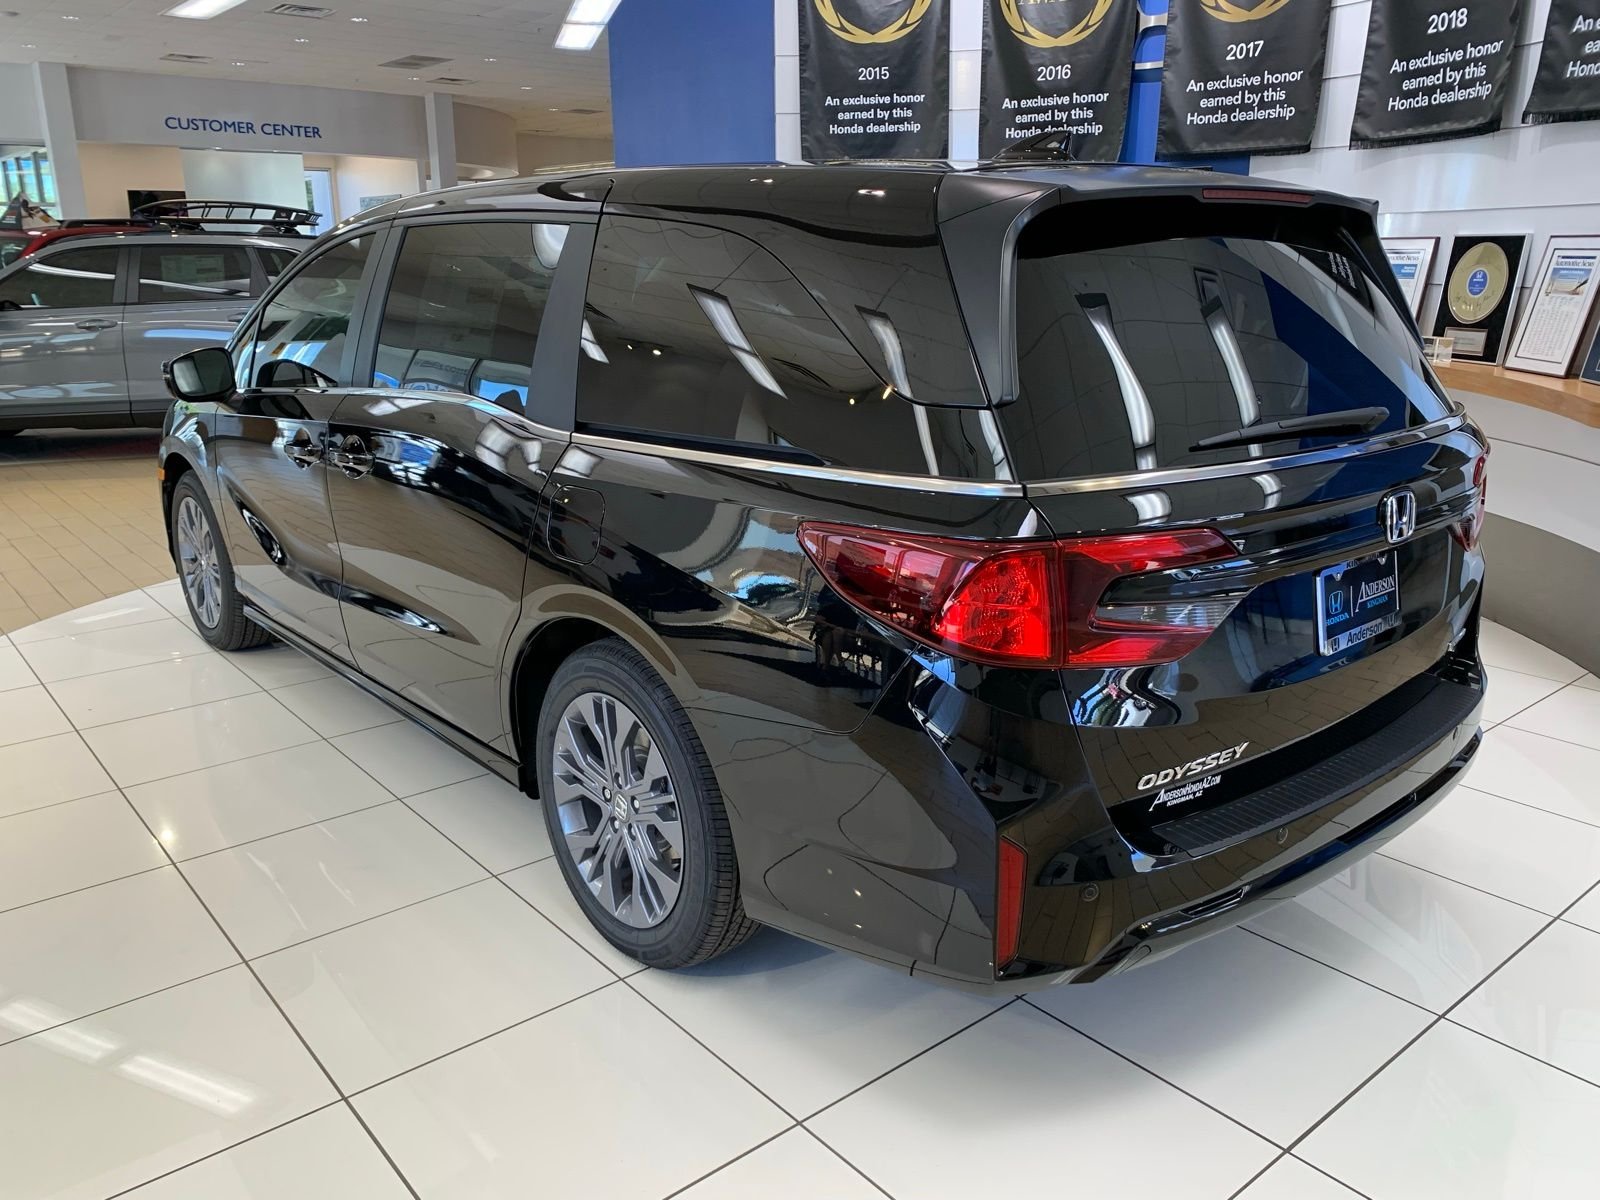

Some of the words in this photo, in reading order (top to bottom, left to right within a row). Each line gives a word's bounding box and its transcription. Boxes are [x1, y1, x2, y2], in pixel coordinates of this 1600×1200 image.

[1427, 8, 1468, 35] 2018
[1572, 15, 1593, 33] An
[1226, 40, 1265, 61] 2017
[1390, 59, 1408, 74] An
[1409, 49, 1463, 70] exclusive
[1466, 38, 1504, 60] honor
[858, 66, 889, 81] 2015
[1037, 64, 1071, 81] 2016
[1186, 78, 1205, 93] An
[1206, 73, 1261, 90] exclusive
[1263, 68, 1304, 85] honor
[1402, 73, 1444, 90] earned
[1446, 67, 1464, 87] by
[1465, 62, 1487, 80] this
[824, 95, 840, 106] An
[842, 94, 891, 105] exclusive
[893, 92, 925, 104] honor
[1002, 98, 1019, 109] An
[1021, 94, 1070, 108] exclusive
[1072, 91, 1109, 105] honor
[1199, 92, 1242, 109] earned
[1243, 90, 1262, 107] by
[1263, 86, 1286, 102] this
[1388, 92, 1429, 112] Honda
[1431, 81, 1492, 107] dealership
[837, 109, 874, 120] earned
[876, 108, 890, 121] by
[892, 107, 912, 118] this
[1015, 111, 1051, 124] earned
[1054, 109, 1069, 124] by
[1070, 107, 1093, 121] this
[1186, 110, 1228, 126] Honda
[1230, 104, 1295, 123] dealership
[164, 116, 257, 135] CUSTOMER
[260, 122, 322, 139] CENTER
[829, 123, 864, 135] Honda
[866, 121, 921, 136] dealership
[1005, 126, 1042, 139] Honda
[1355, 574, 1395, 613] ANDERSON
[1347, 621, 1383, 646] Anderson
[1137, 741, 1249, 791] ODYSSEY
[1195, 790, 1203, 798] AZ
